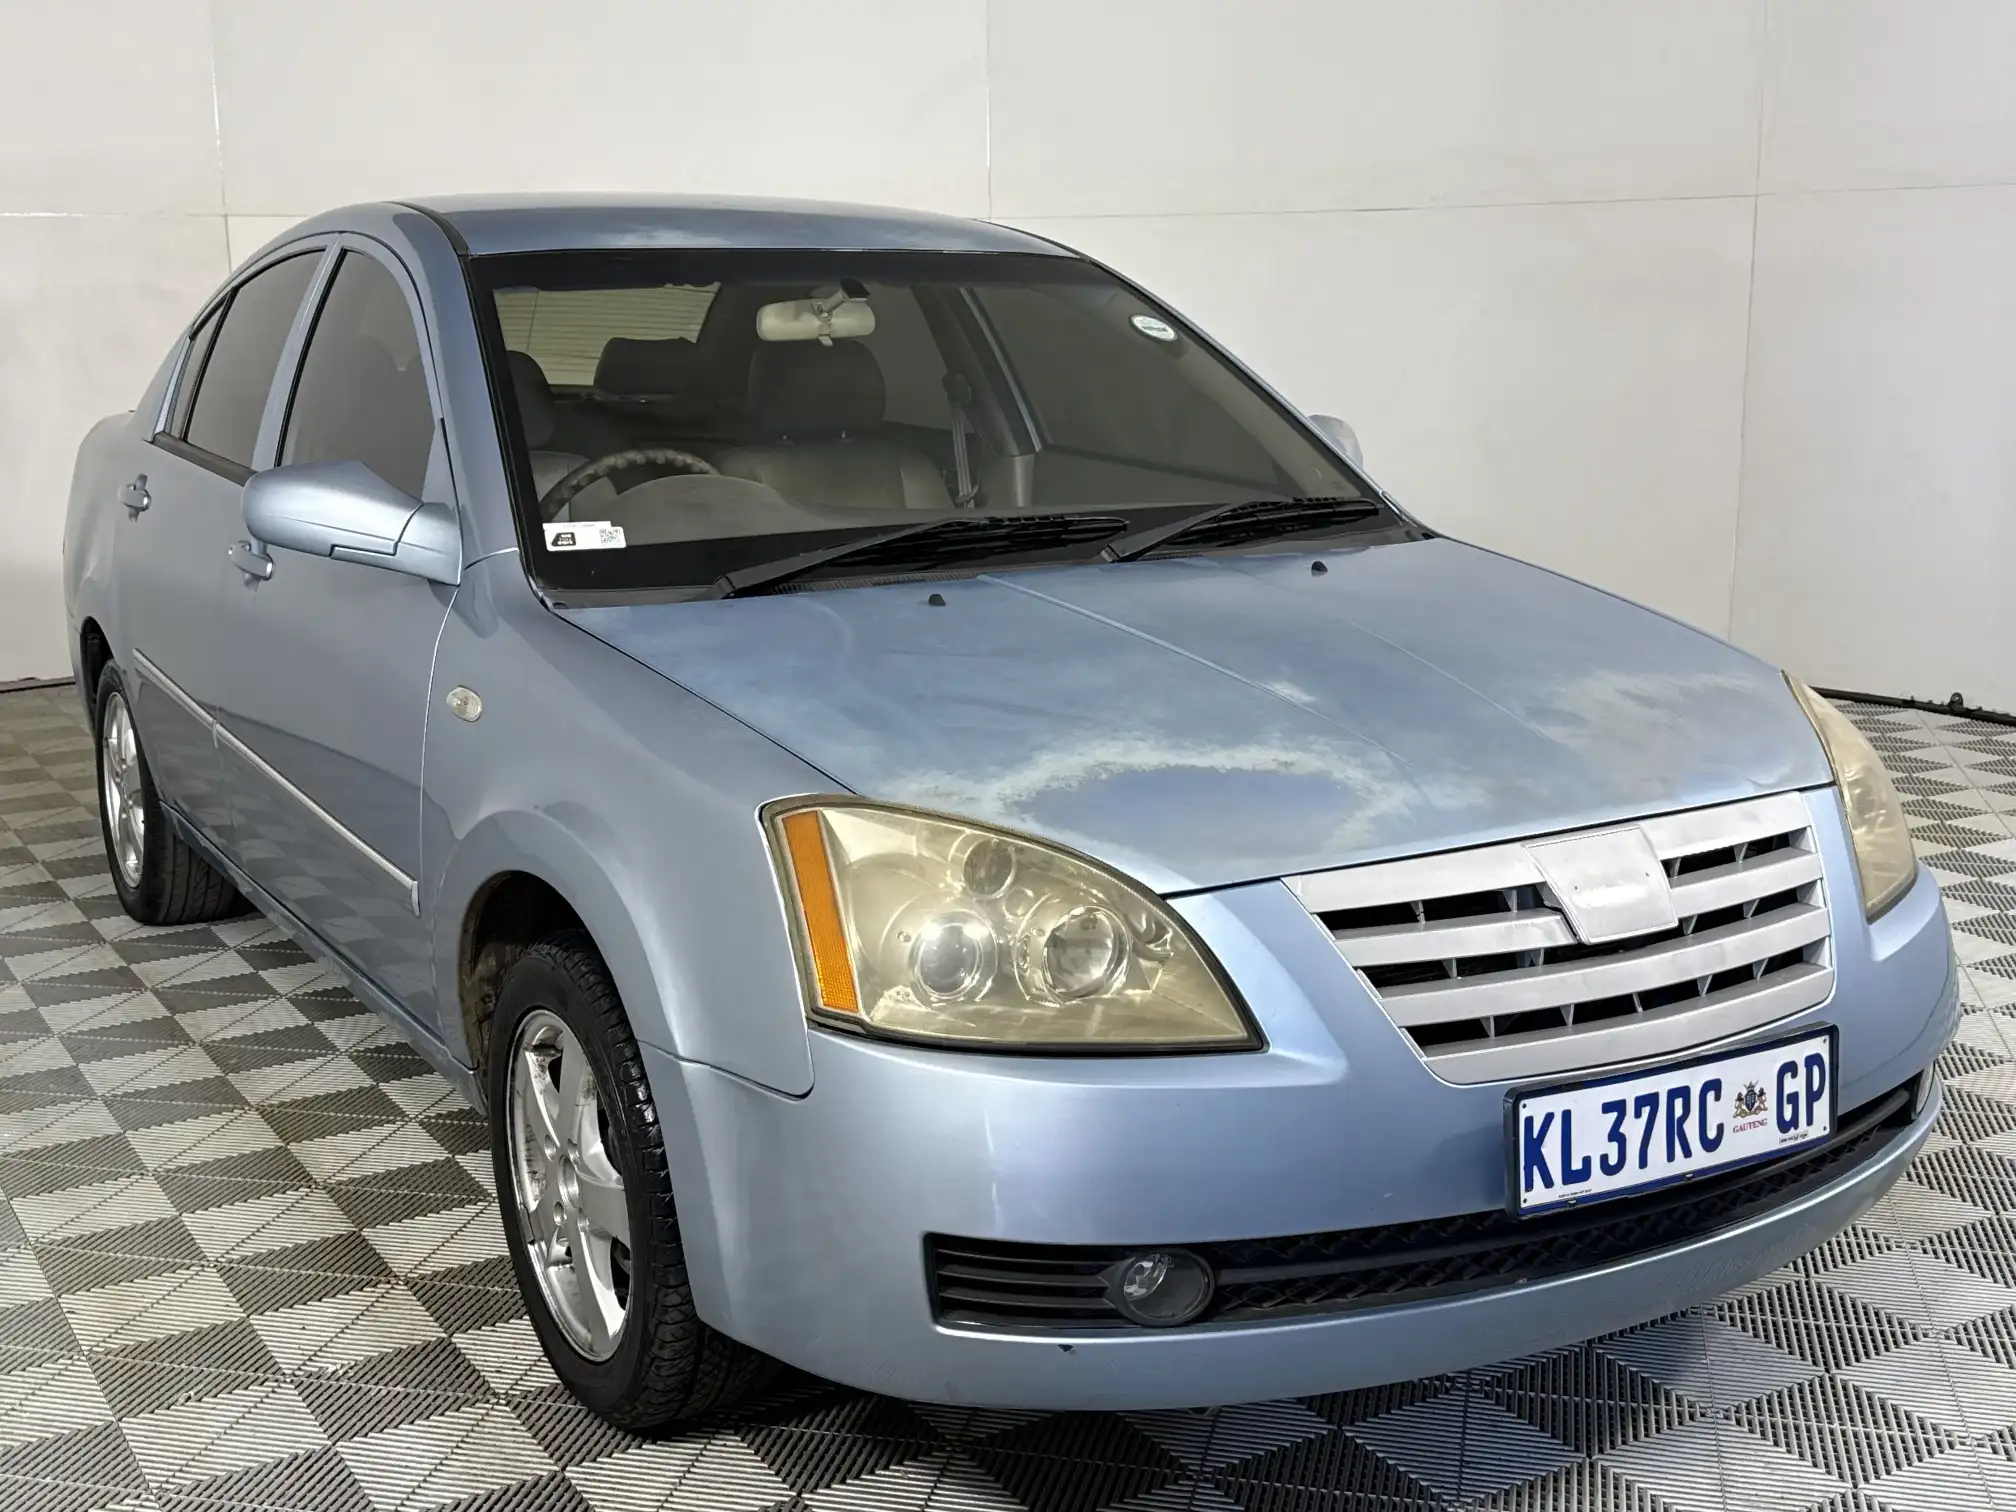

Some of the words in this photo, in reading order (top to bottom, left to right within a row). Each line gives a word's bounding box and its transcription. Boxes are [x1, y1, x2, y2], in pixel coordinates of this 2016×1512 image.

[1524, 1078, 1724, 1192] KL37RC
[1777, 1053, 1825, 1133] GP
[1732, 1118, 1768, 1133] GAUTENG
